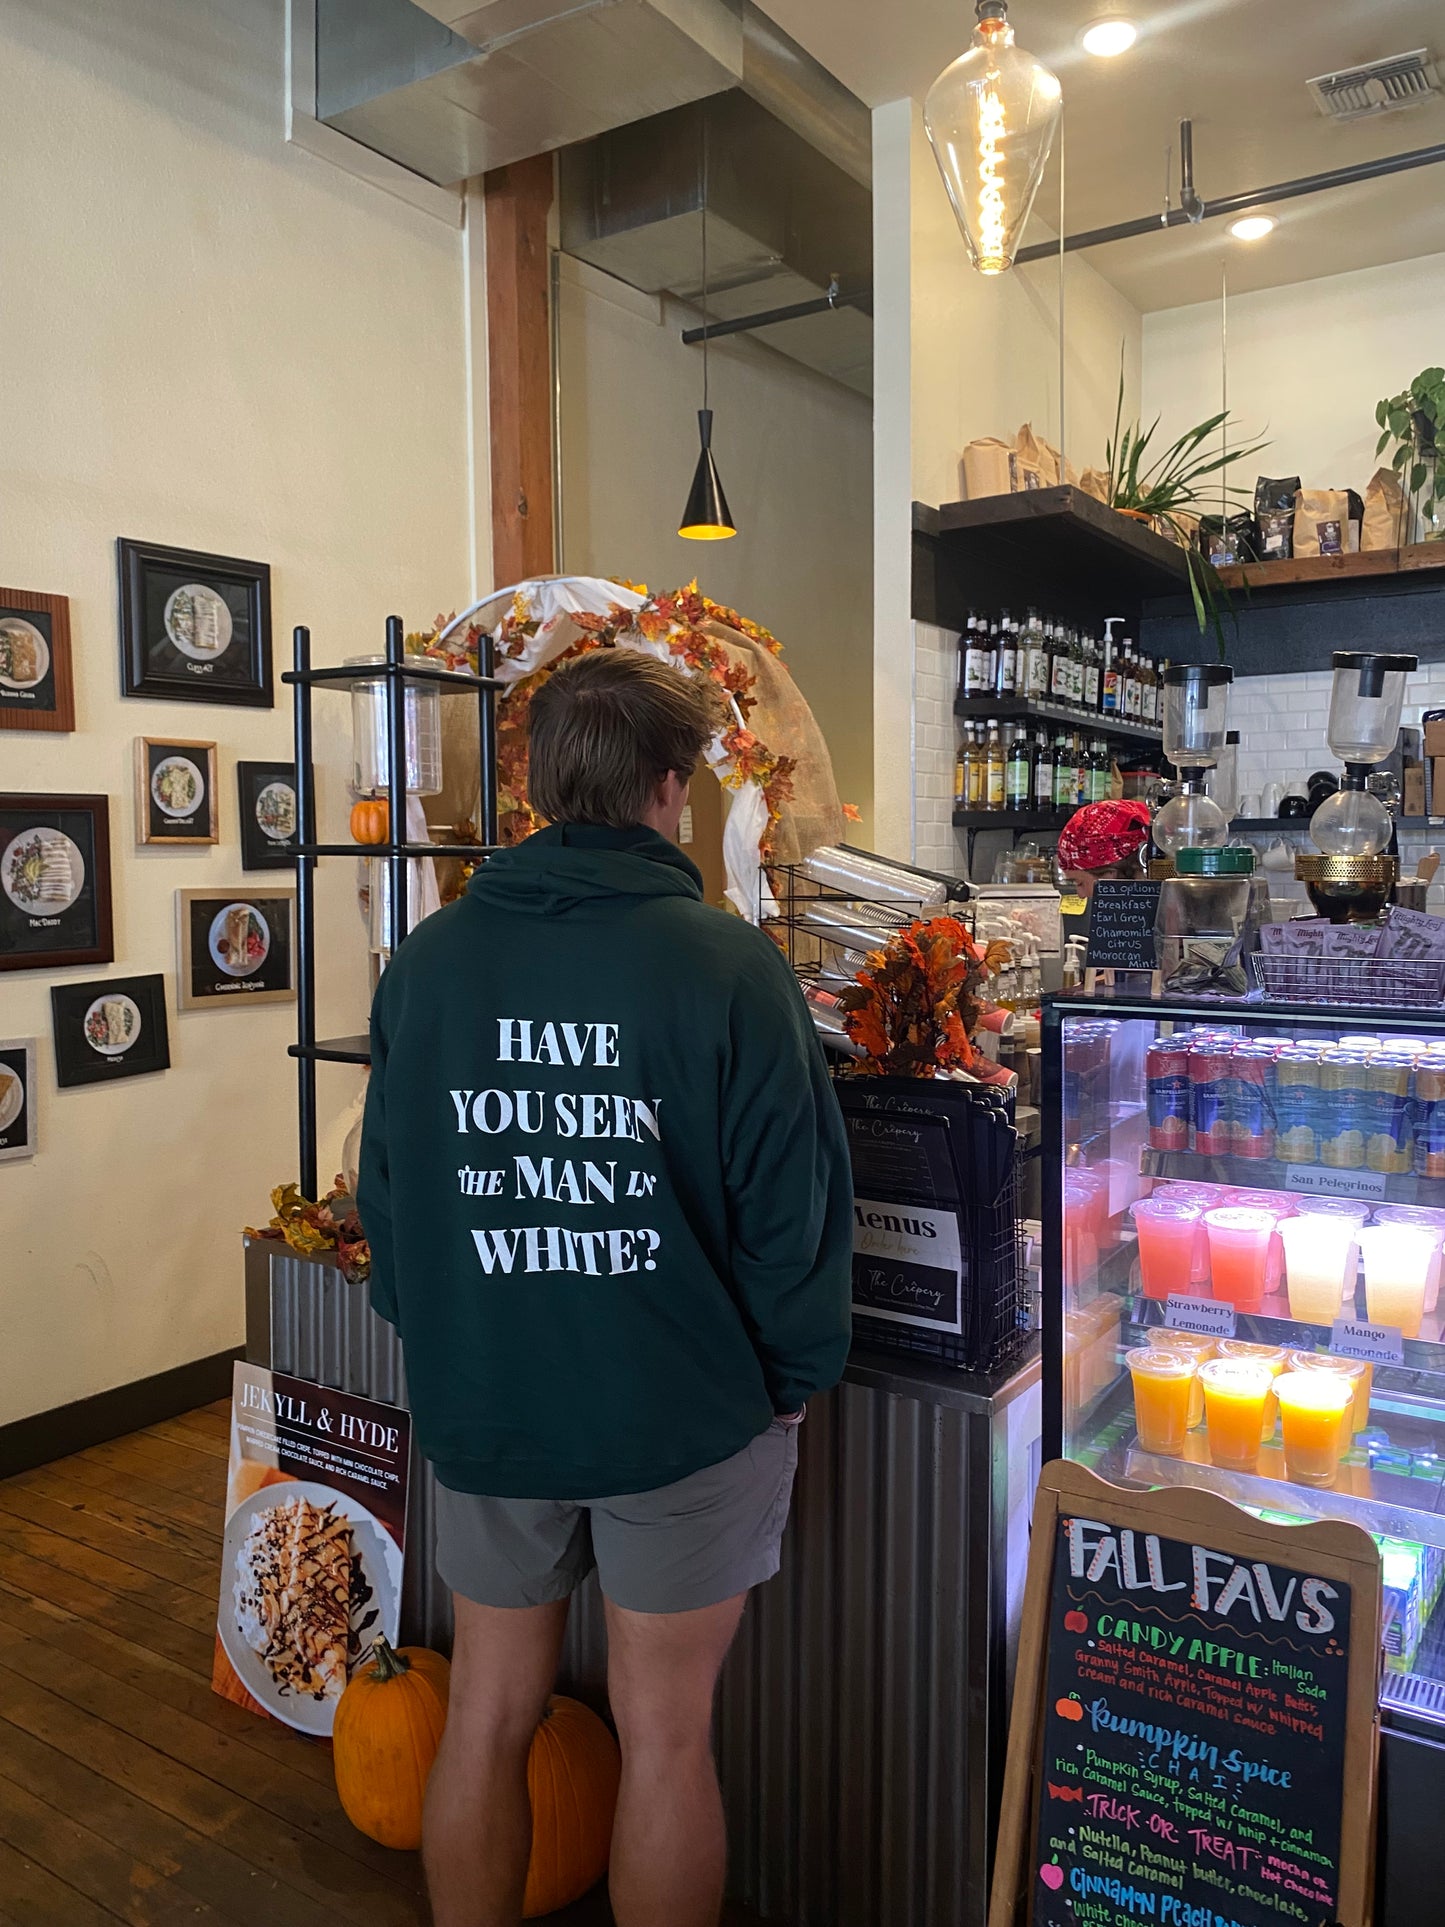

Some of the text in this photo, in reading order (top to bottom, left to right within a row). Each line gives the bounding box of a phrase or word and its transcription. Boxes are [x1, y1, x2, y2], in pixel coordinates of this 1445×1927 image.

[1098, 885, 1116, 893] tea
[1097, 900, 1152, 910] Breakfast
[1097, 912, 1146, 927] Earl Grey
[1096, 926, 1152, 938] Chamomile
[1092, 950, 1140, 961] Moroccan
[496, 1018, 619, 1067] HAVE
[450, 1089, 662, 1143] YOU SEEN
[862, 1094, 881, 1109] The
[512, 1155, 617, 1205] MAN
[625, 1171, 656, 1198] IN
[1291, 1174, 1383, 1193] San Pelegrinos
[470, 1227, 661, 1276] WHITE?
[868, 1269, 888, 1291] The
[890, 1273, 944, 1306] Crêpery
[1166, 1298, 1233, 1319] Strawberry
[1171, 1317, 1230, 1335] Lemonade
[1343, 1325, 1386, 1341] Mango
[1334, 1343, 1399, 1362] Lemonade
[241, 1383, 399, 1453] JEKYLL & HYDE
[281, 1448, 308, 1463] CHOCOLATE
[347, 1471, 370, 1483] CARAMEL
[312, 1448, 330, 1460] TOPPED
[354, 1462, 384, 1477] CHOCOLATE
[1068, 1518, 1339, 1634] FALL FAVS
[1097, 1614, 1185, 1656] CANDY
[1272, 1659, 1314, 1681] Italian
[1075, 1649, 1119, 1675] Granny
[1124, 1662, 1160, 1682] Smith
[1202, 1685, 1243, 1709] Topped
[1098, 1639, 1136, 1661] Salted
[1245, 1682, 1278, 1701] Apple
[1119, 1678, 1144, 1695] and
[1149, 1687, 1173, 1702] rich
[1296, 1682, 1327, 1700] Soda
[1085, 1697, 1292, 1789] Pumpkin Spice
[1055, 1757, 1078, 1776] rich
[1172, 1797, 1211, 1821] topped
[1086, 1748, 1139, 1778] Pumpkin
[1187, 1787, 1226, 1812] Salted
[1290, 1828, 1313, 1845] and
[1087, 1794, 1141, 1830] TRICK
[1050, 1837, 1076, 1855] and
[1082, 1844, 1123, 1872] Salted
[1140, 1844, 1188, 1874] Peanut
[1261, 1866, 1282, 1884] Hot
[1074, 1901, 1112, 1922] White
